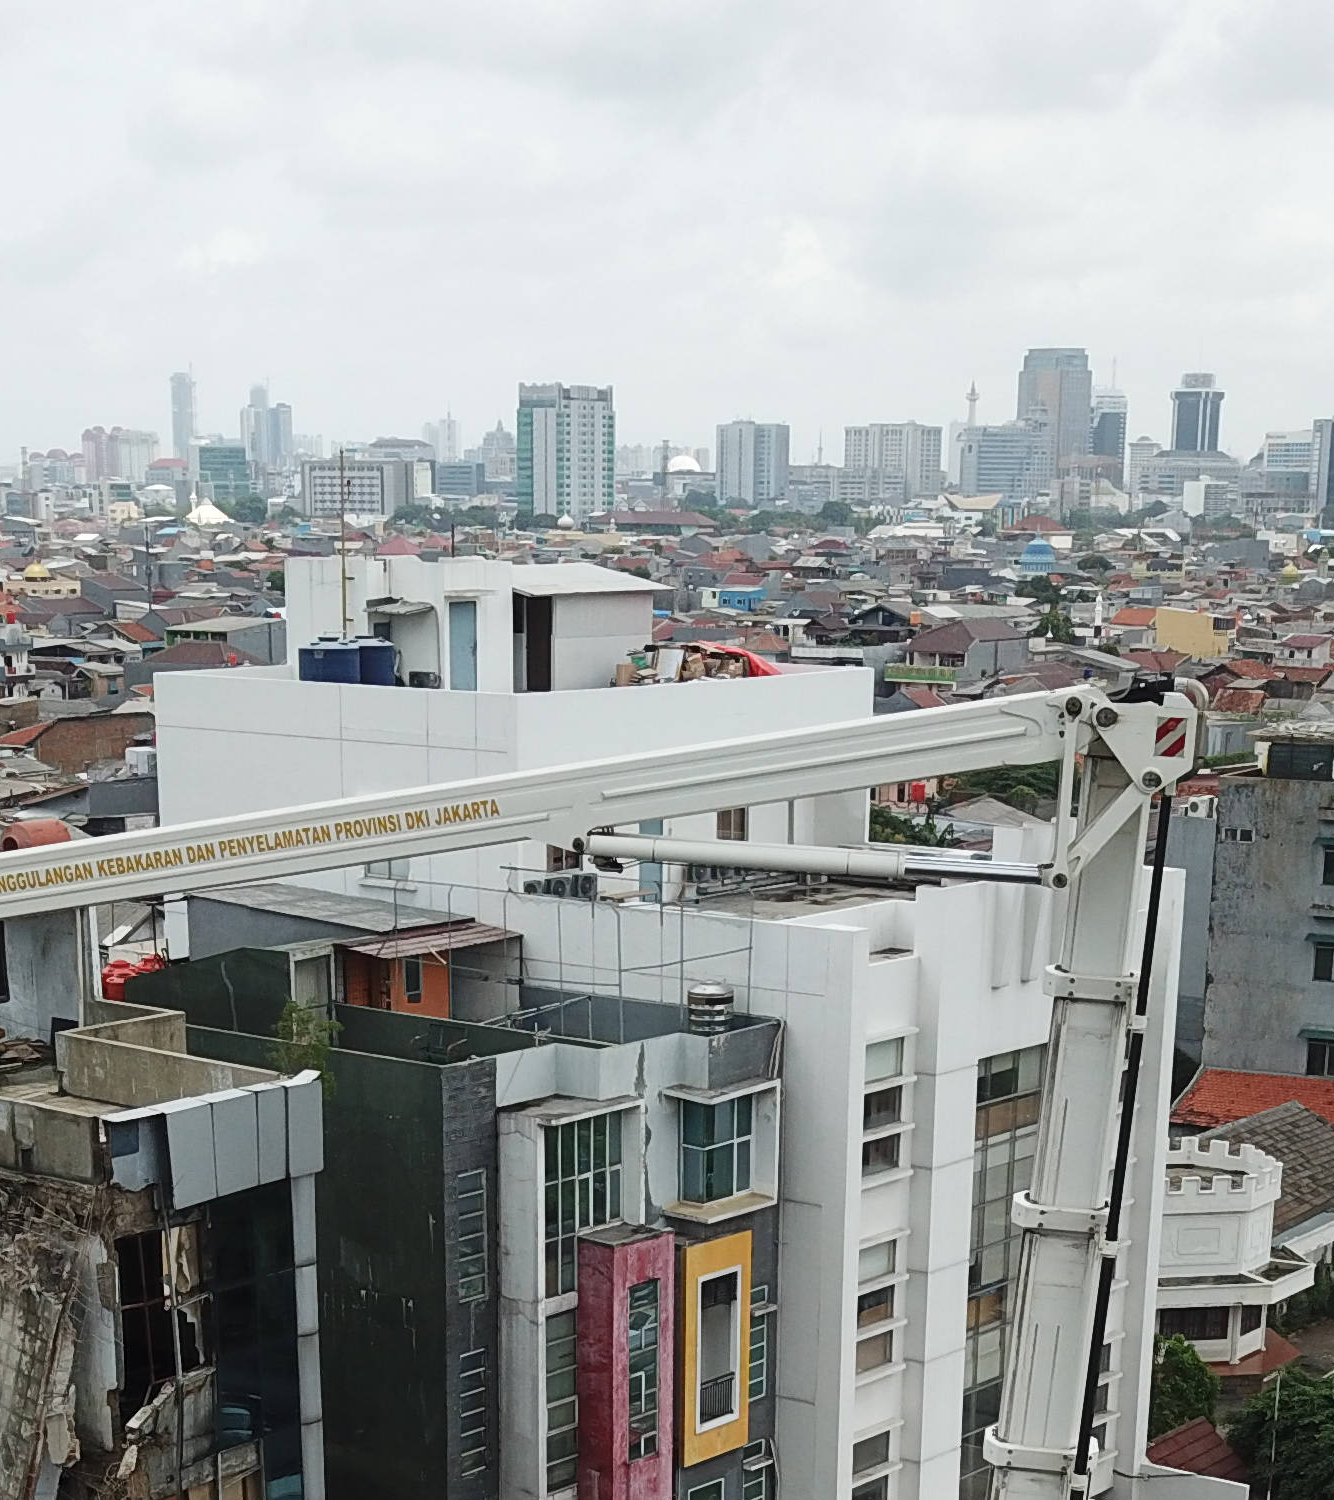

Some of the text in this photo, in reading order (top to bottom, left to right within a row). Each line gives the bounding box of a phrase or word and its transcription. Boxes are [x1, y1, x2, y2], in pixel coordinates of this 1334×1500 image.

[96, 847, 184, 878] KEBAKARAN
[186, 843, 216, 865] DAN
[218, 824, 332, 860] PENYELAMATAN
[334, 810, 403, 842] PROVINSI
[404, 806, 432, 831] DKI
[433, 797, 501, 828] JAKARTA
